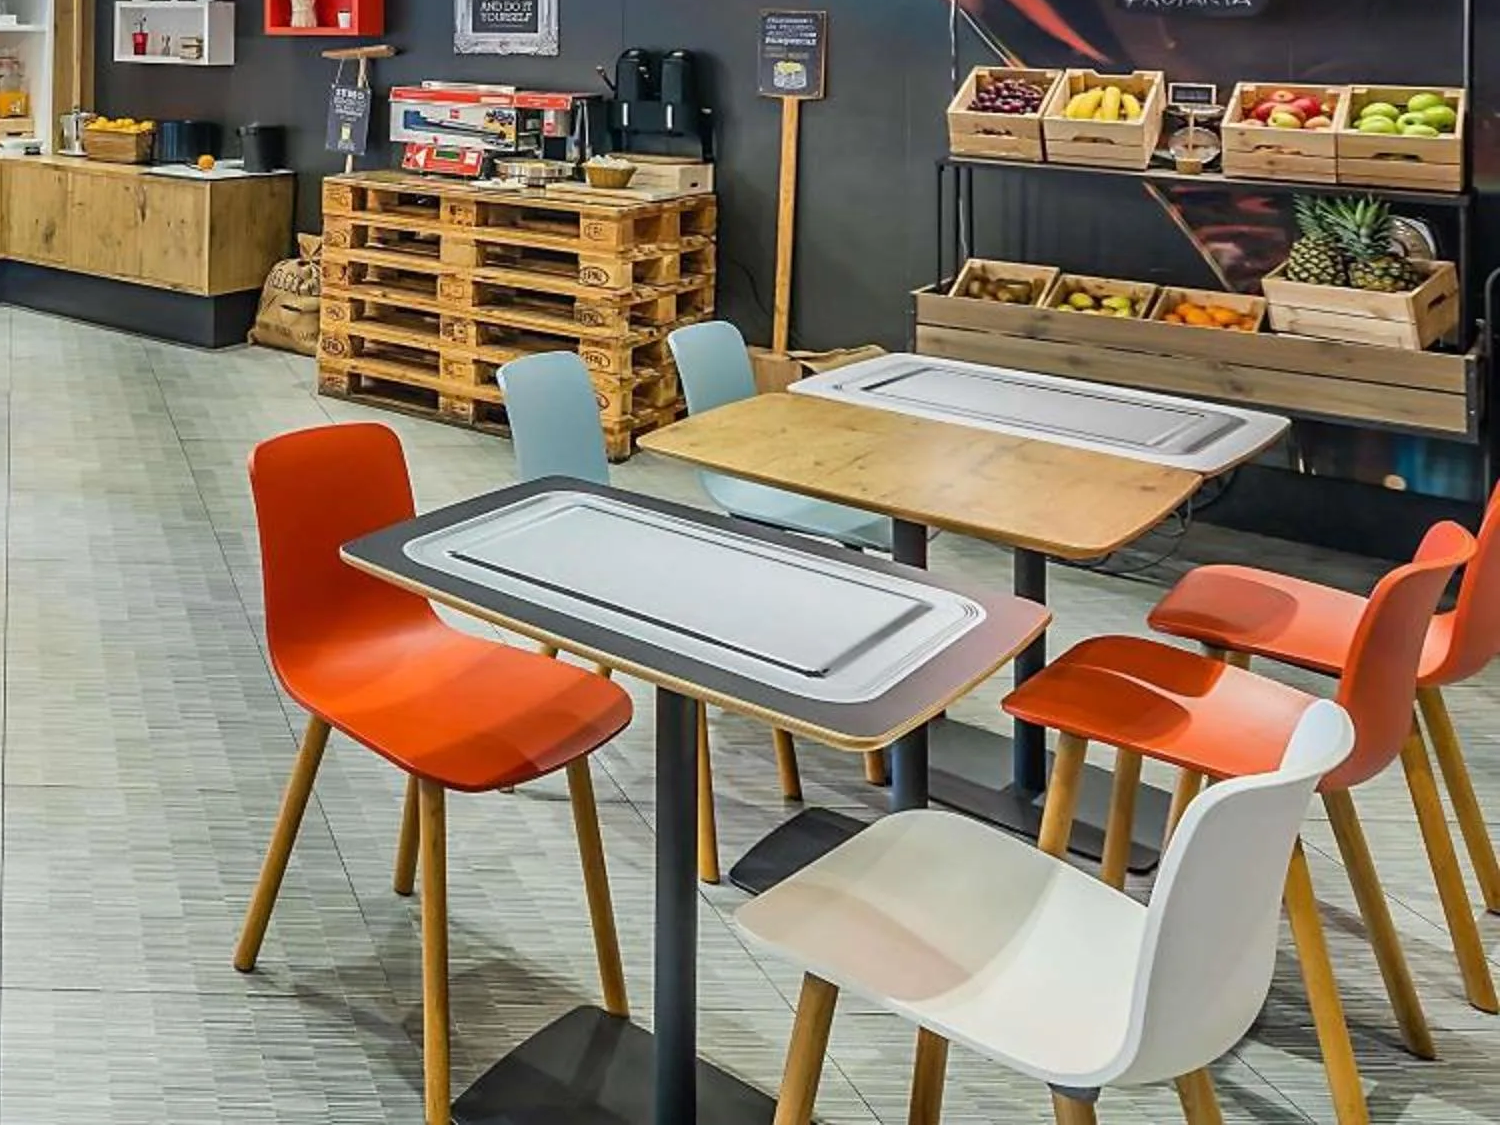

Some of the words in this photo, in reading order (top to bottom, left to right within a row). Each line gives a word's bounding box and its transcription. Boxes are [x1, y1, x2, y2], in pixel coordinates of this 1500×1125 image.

[480, 1, 502, 12] AND
[504, 1, 521, 12] DO
[522, 1, 533, 12] IT
